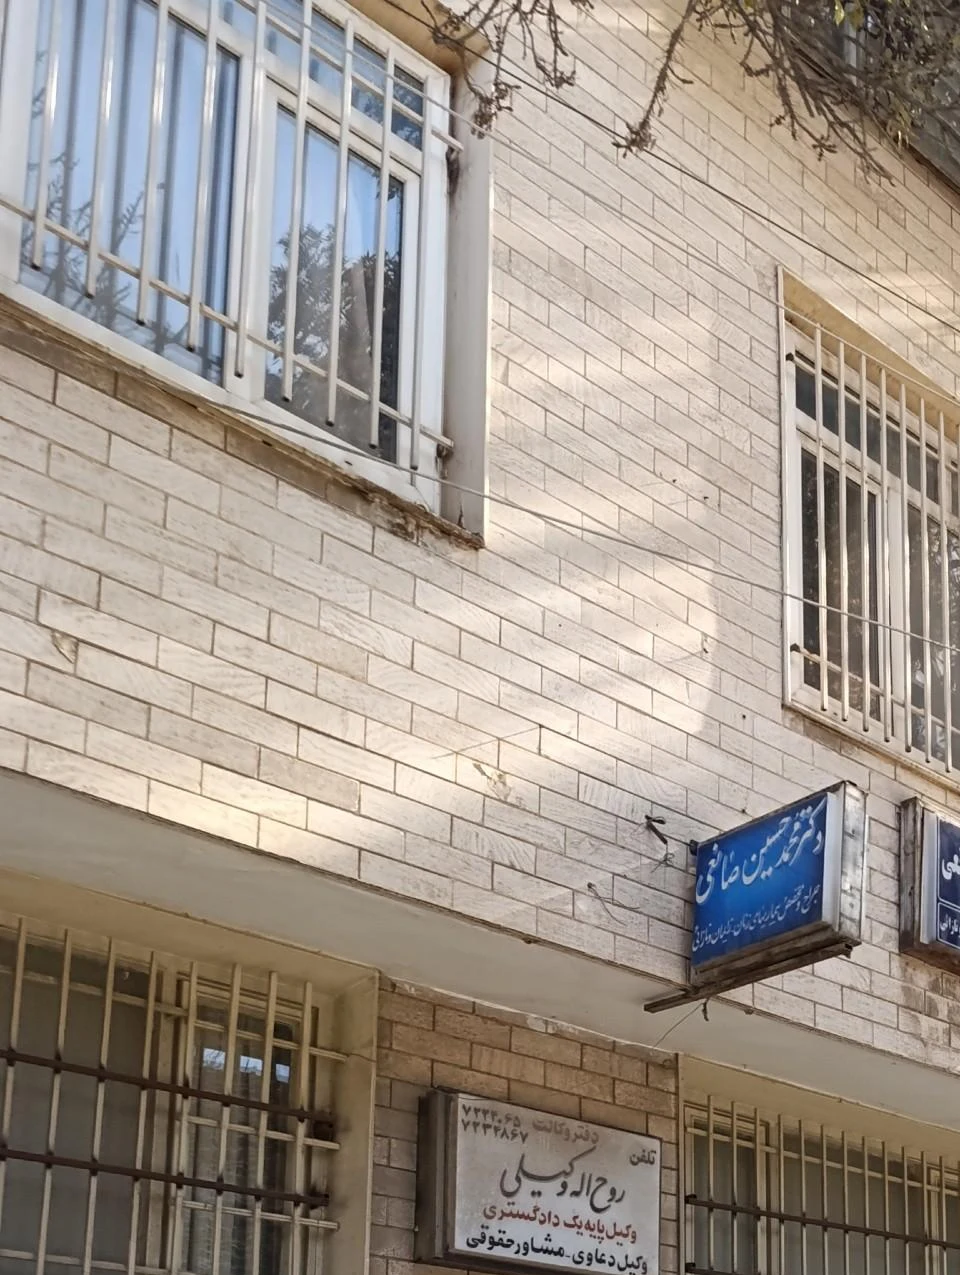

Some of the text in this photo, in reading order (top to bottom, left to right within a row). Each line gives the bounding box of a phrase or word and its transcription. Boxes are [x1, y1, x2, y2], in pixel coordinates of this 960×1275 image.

[743, 816, 792, 885] حسین
[774, 812, 801, 868] محمد
[790, 797, 827, 866] دکتر
[532, 1116, 599, 1144] دفتر وکالت
[629, 1149, 657, 1166] تلفن
[590, 1174, 626, 1213] روح
[466, 1223, 515, 1249] حقوقی
[483, 1200, 637, 1246] وکیل پایه یک دادگستری
